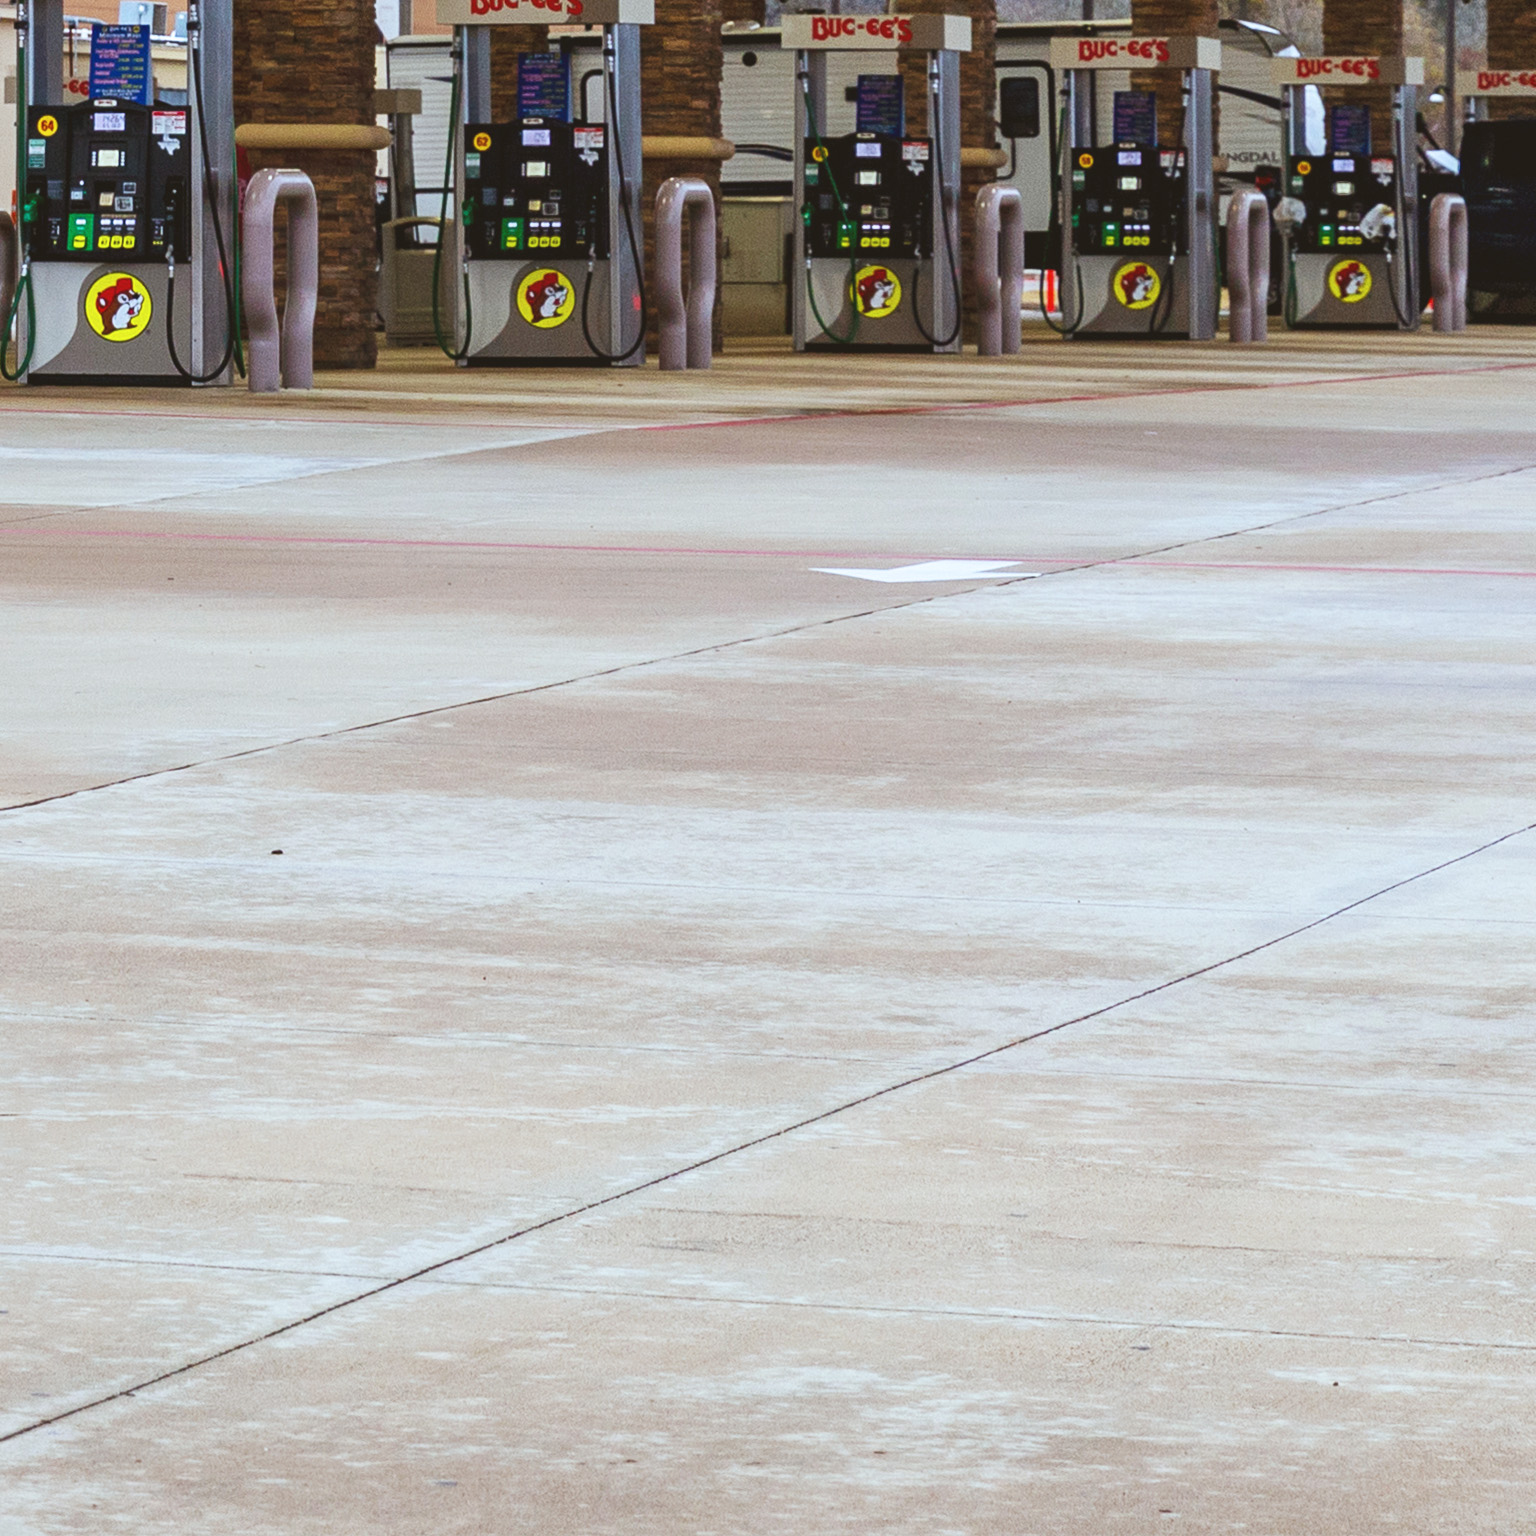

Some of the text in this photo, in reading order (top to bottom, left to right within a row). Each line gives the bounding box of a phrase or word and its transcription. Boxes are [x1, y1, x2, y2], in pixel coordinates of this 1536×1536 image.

[812, 17, 912, 42] BUC-EE'S
[1078, 40, 1170, 63] BUC-EE'S
[1296, 58, 1380, 78] BUC-EE'S
[1477, 72, 1536, 90] BUC-EE
[40, 119, 54, 132] 64
[476, 136, 488, 147] 62
